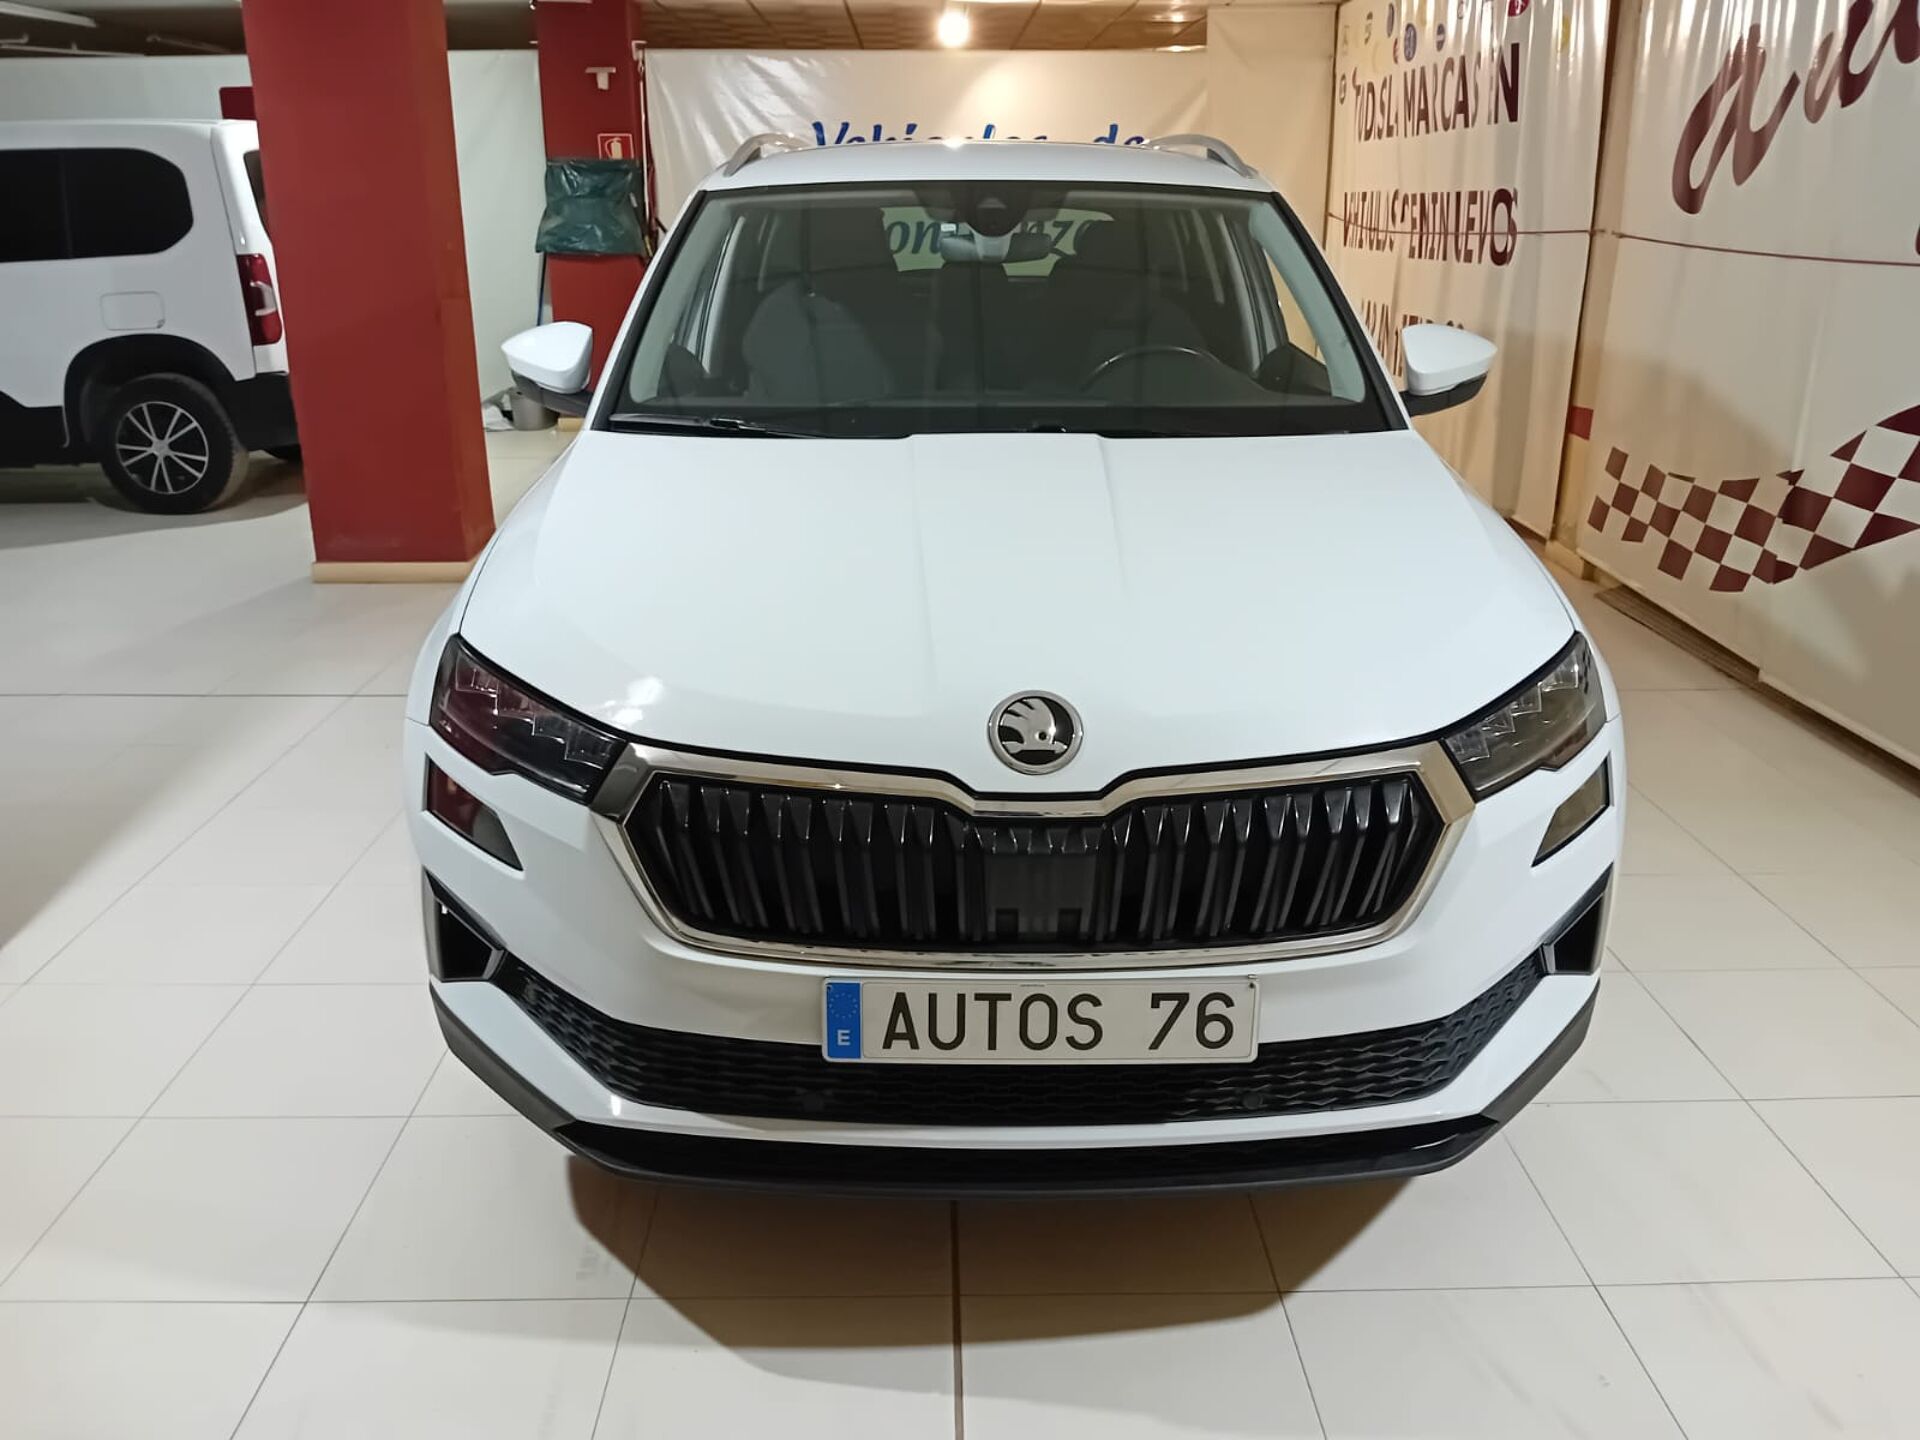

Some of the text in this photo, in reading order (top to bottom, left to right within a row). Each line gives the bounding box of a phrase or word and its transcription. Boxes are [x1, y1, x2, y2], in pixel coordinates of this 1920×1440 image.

[837, 1029, 851, 1046] E
[882, 992, 1235, 1050] AUTOS 76
